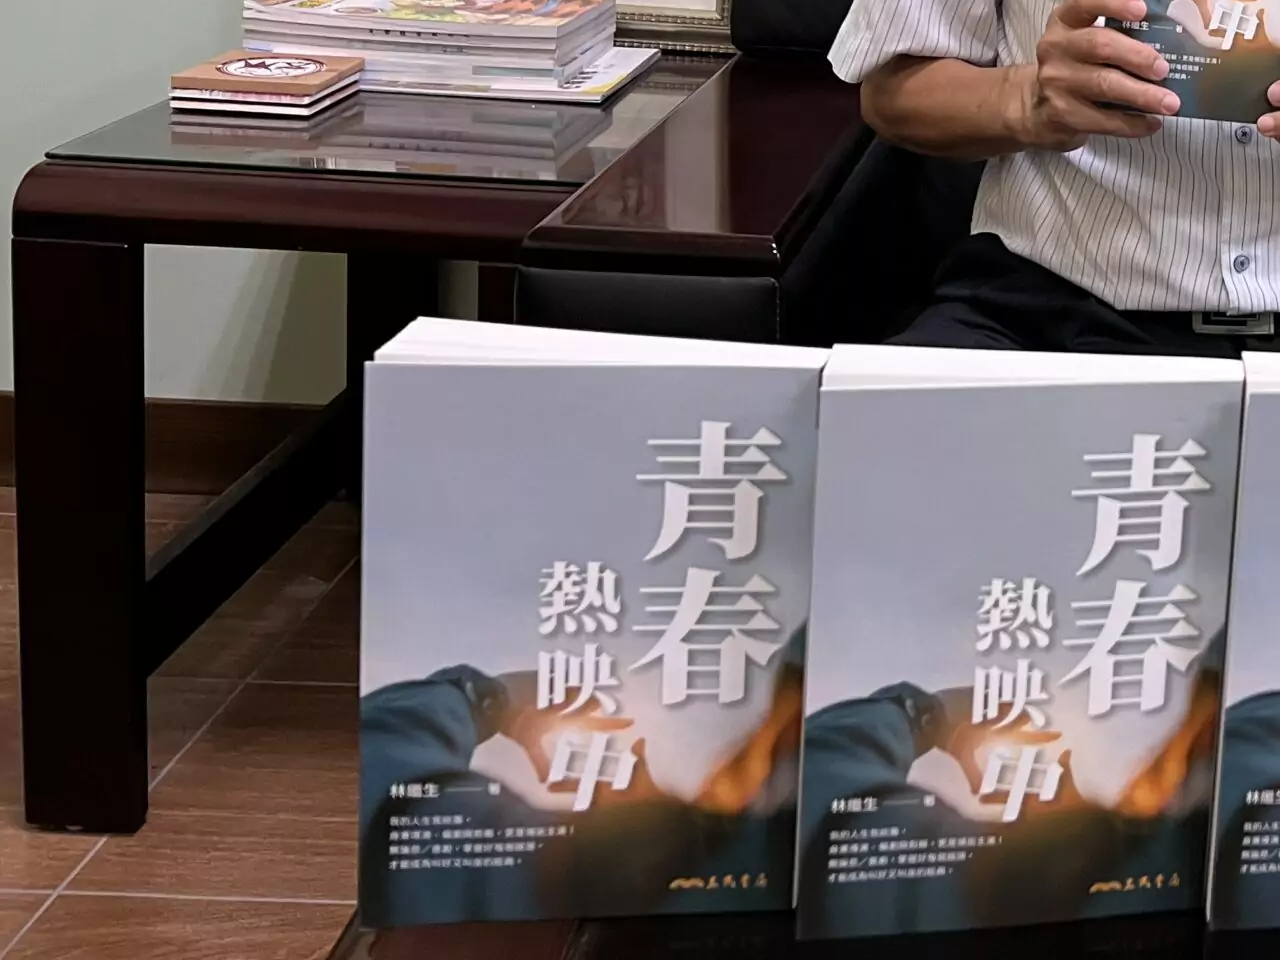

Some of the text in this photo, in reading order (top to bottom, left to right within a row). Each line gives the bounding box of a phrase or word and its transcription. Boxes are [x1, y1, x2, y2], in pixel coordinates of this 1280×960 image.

[536, 560, 638, 812] 熱映中
[628, 420, 787, 706] 青春
[1057, 433, 1211, 716] 青春
[971, 577, 1064, 823] 熱映中
